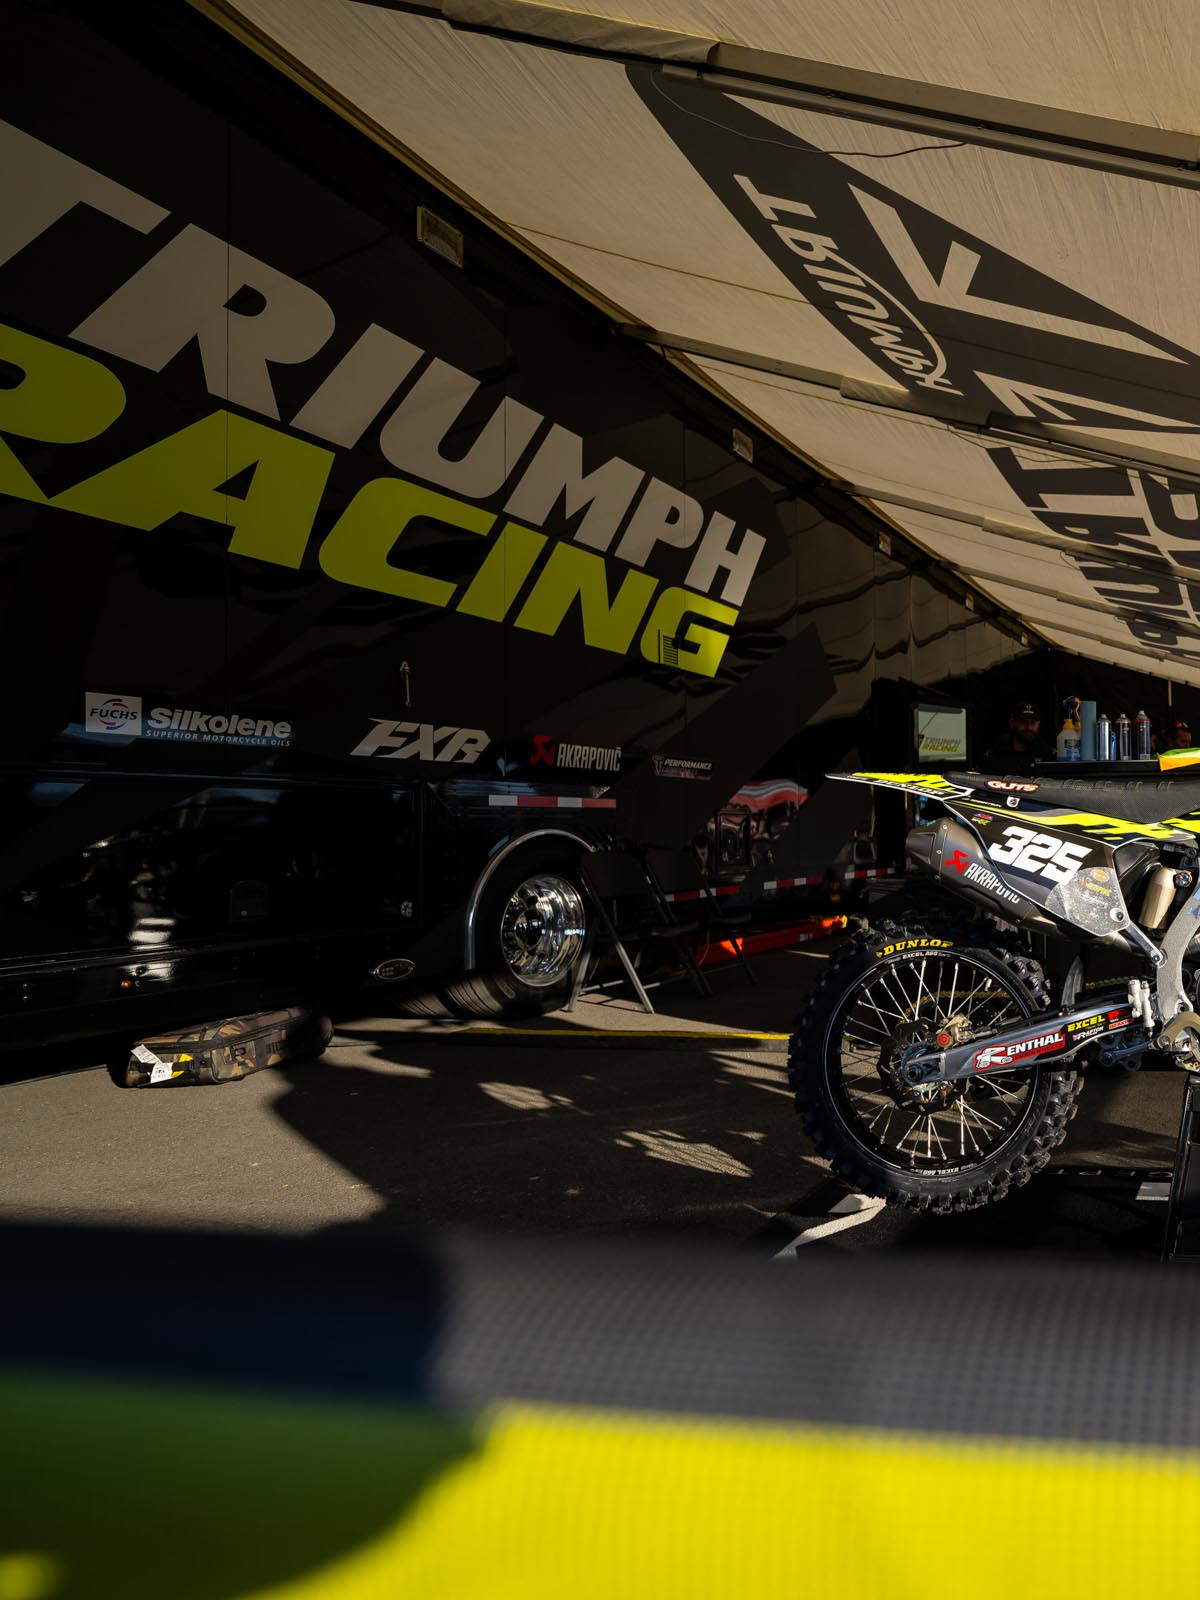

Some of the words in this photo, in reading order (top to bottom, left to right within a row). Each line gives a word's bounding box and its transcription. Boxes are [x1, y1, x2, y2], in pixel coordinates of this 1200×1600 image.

[0, 115, 766, 606] TRIUMPH
[90, 707, 138, 720] FUCHS
[147, 707, 293, 738] Silkolene
[146, 730, 198, 741] SUPERIOR
[203, 734, 266, 745] MOTORCYCLE
[271, 739, 291, 747] OILS
[350, 717, 492, 765] FXR
[987, 780, 1039, 791] GUTS
[988, 826, 1093, 884] 325
[882, 938, 955, 956] DUNLOP
[1067, 1015, 1106, 1032] EXCEL
[976, 1032, 1064, 1068] RENTHAL
